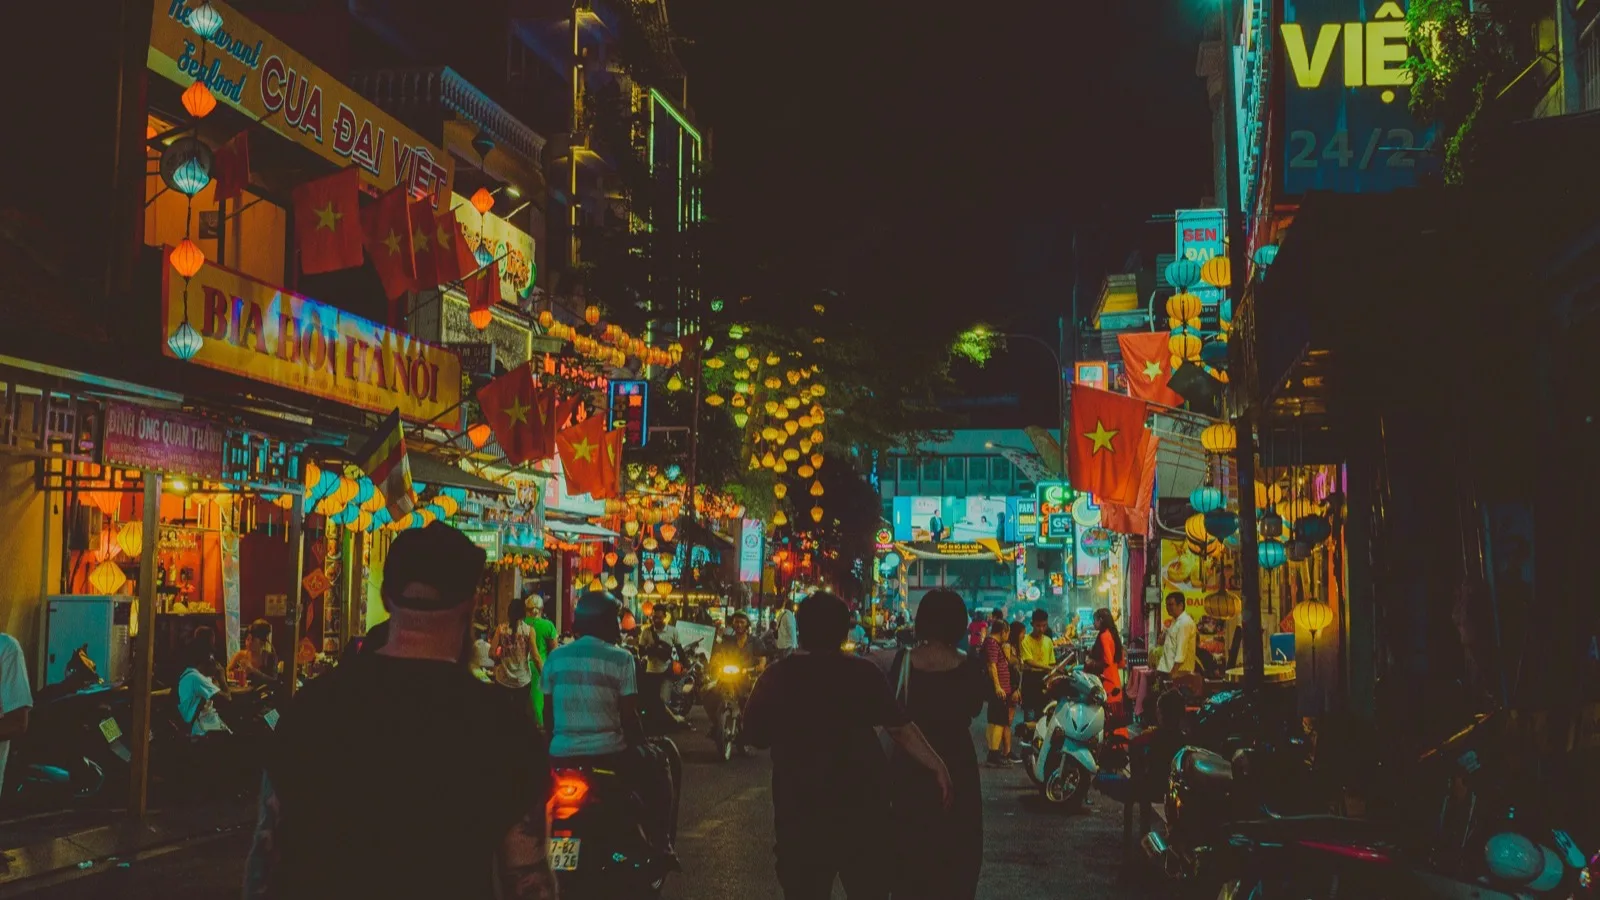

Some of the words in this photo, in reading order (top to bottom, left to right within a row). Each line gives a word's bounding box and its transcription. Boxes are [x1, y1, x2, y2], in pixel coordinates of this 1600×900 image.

[260, 55, 323, 143] CUA
[1183, 228, 1217, 242] SEN
[201, 285, 267, 354] BIA
[138, 409, 160, 442] ÔNG
